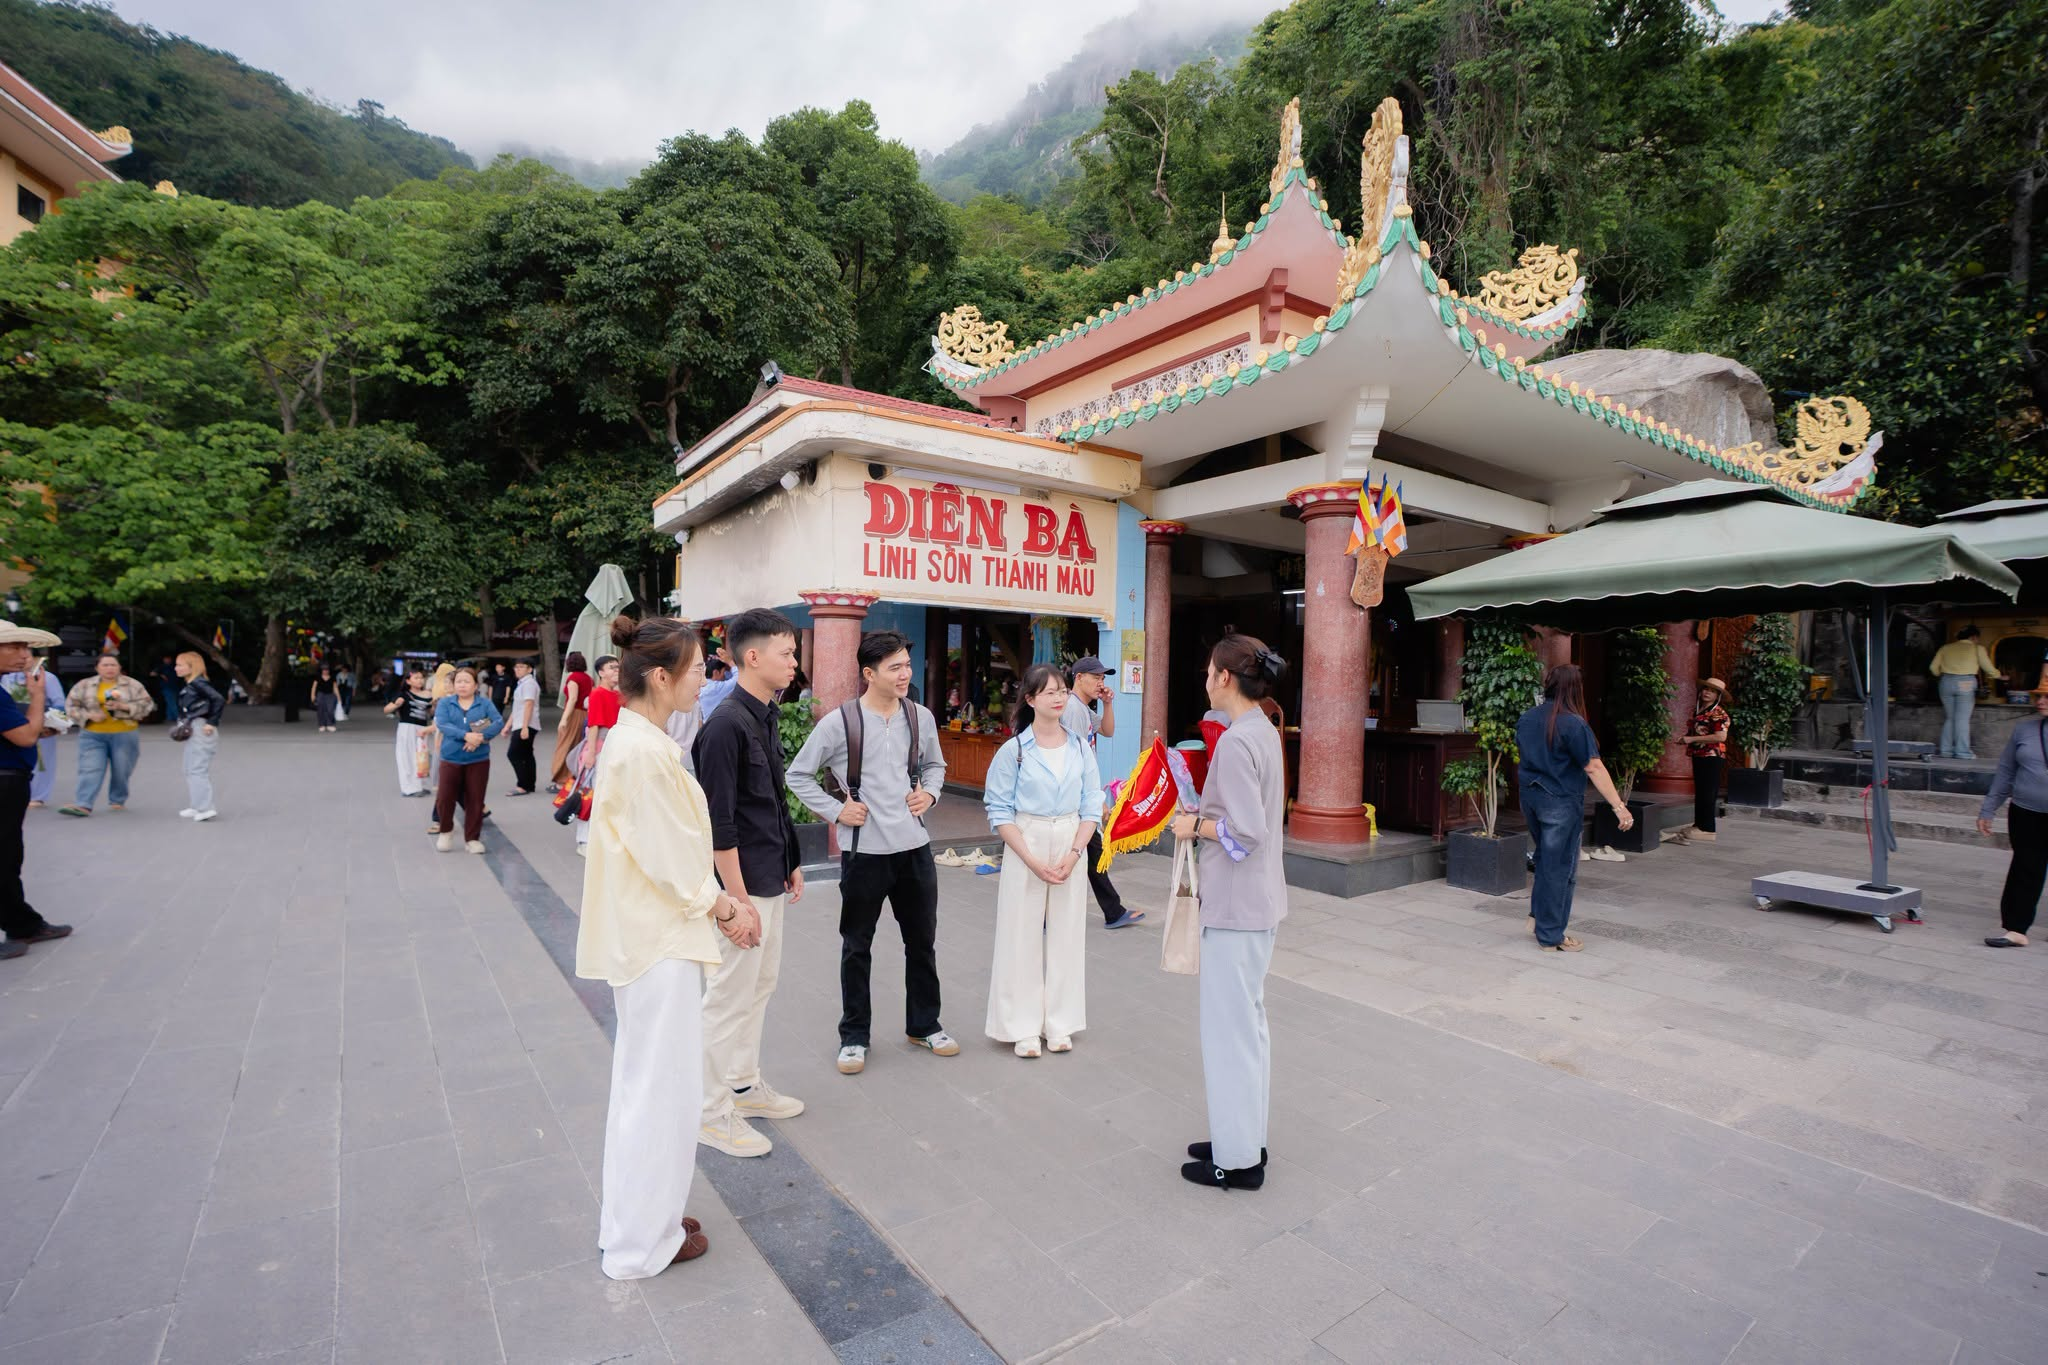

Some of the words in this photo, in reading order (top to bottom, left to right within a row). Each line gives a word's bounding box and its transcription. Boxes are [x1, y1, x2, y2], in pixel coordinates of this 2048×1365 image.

[1023, 502, 1097, 563] BÀ
[982, 551, 1047, 592] THÁNH
[1057, 560, 1094, 597] MẪU
